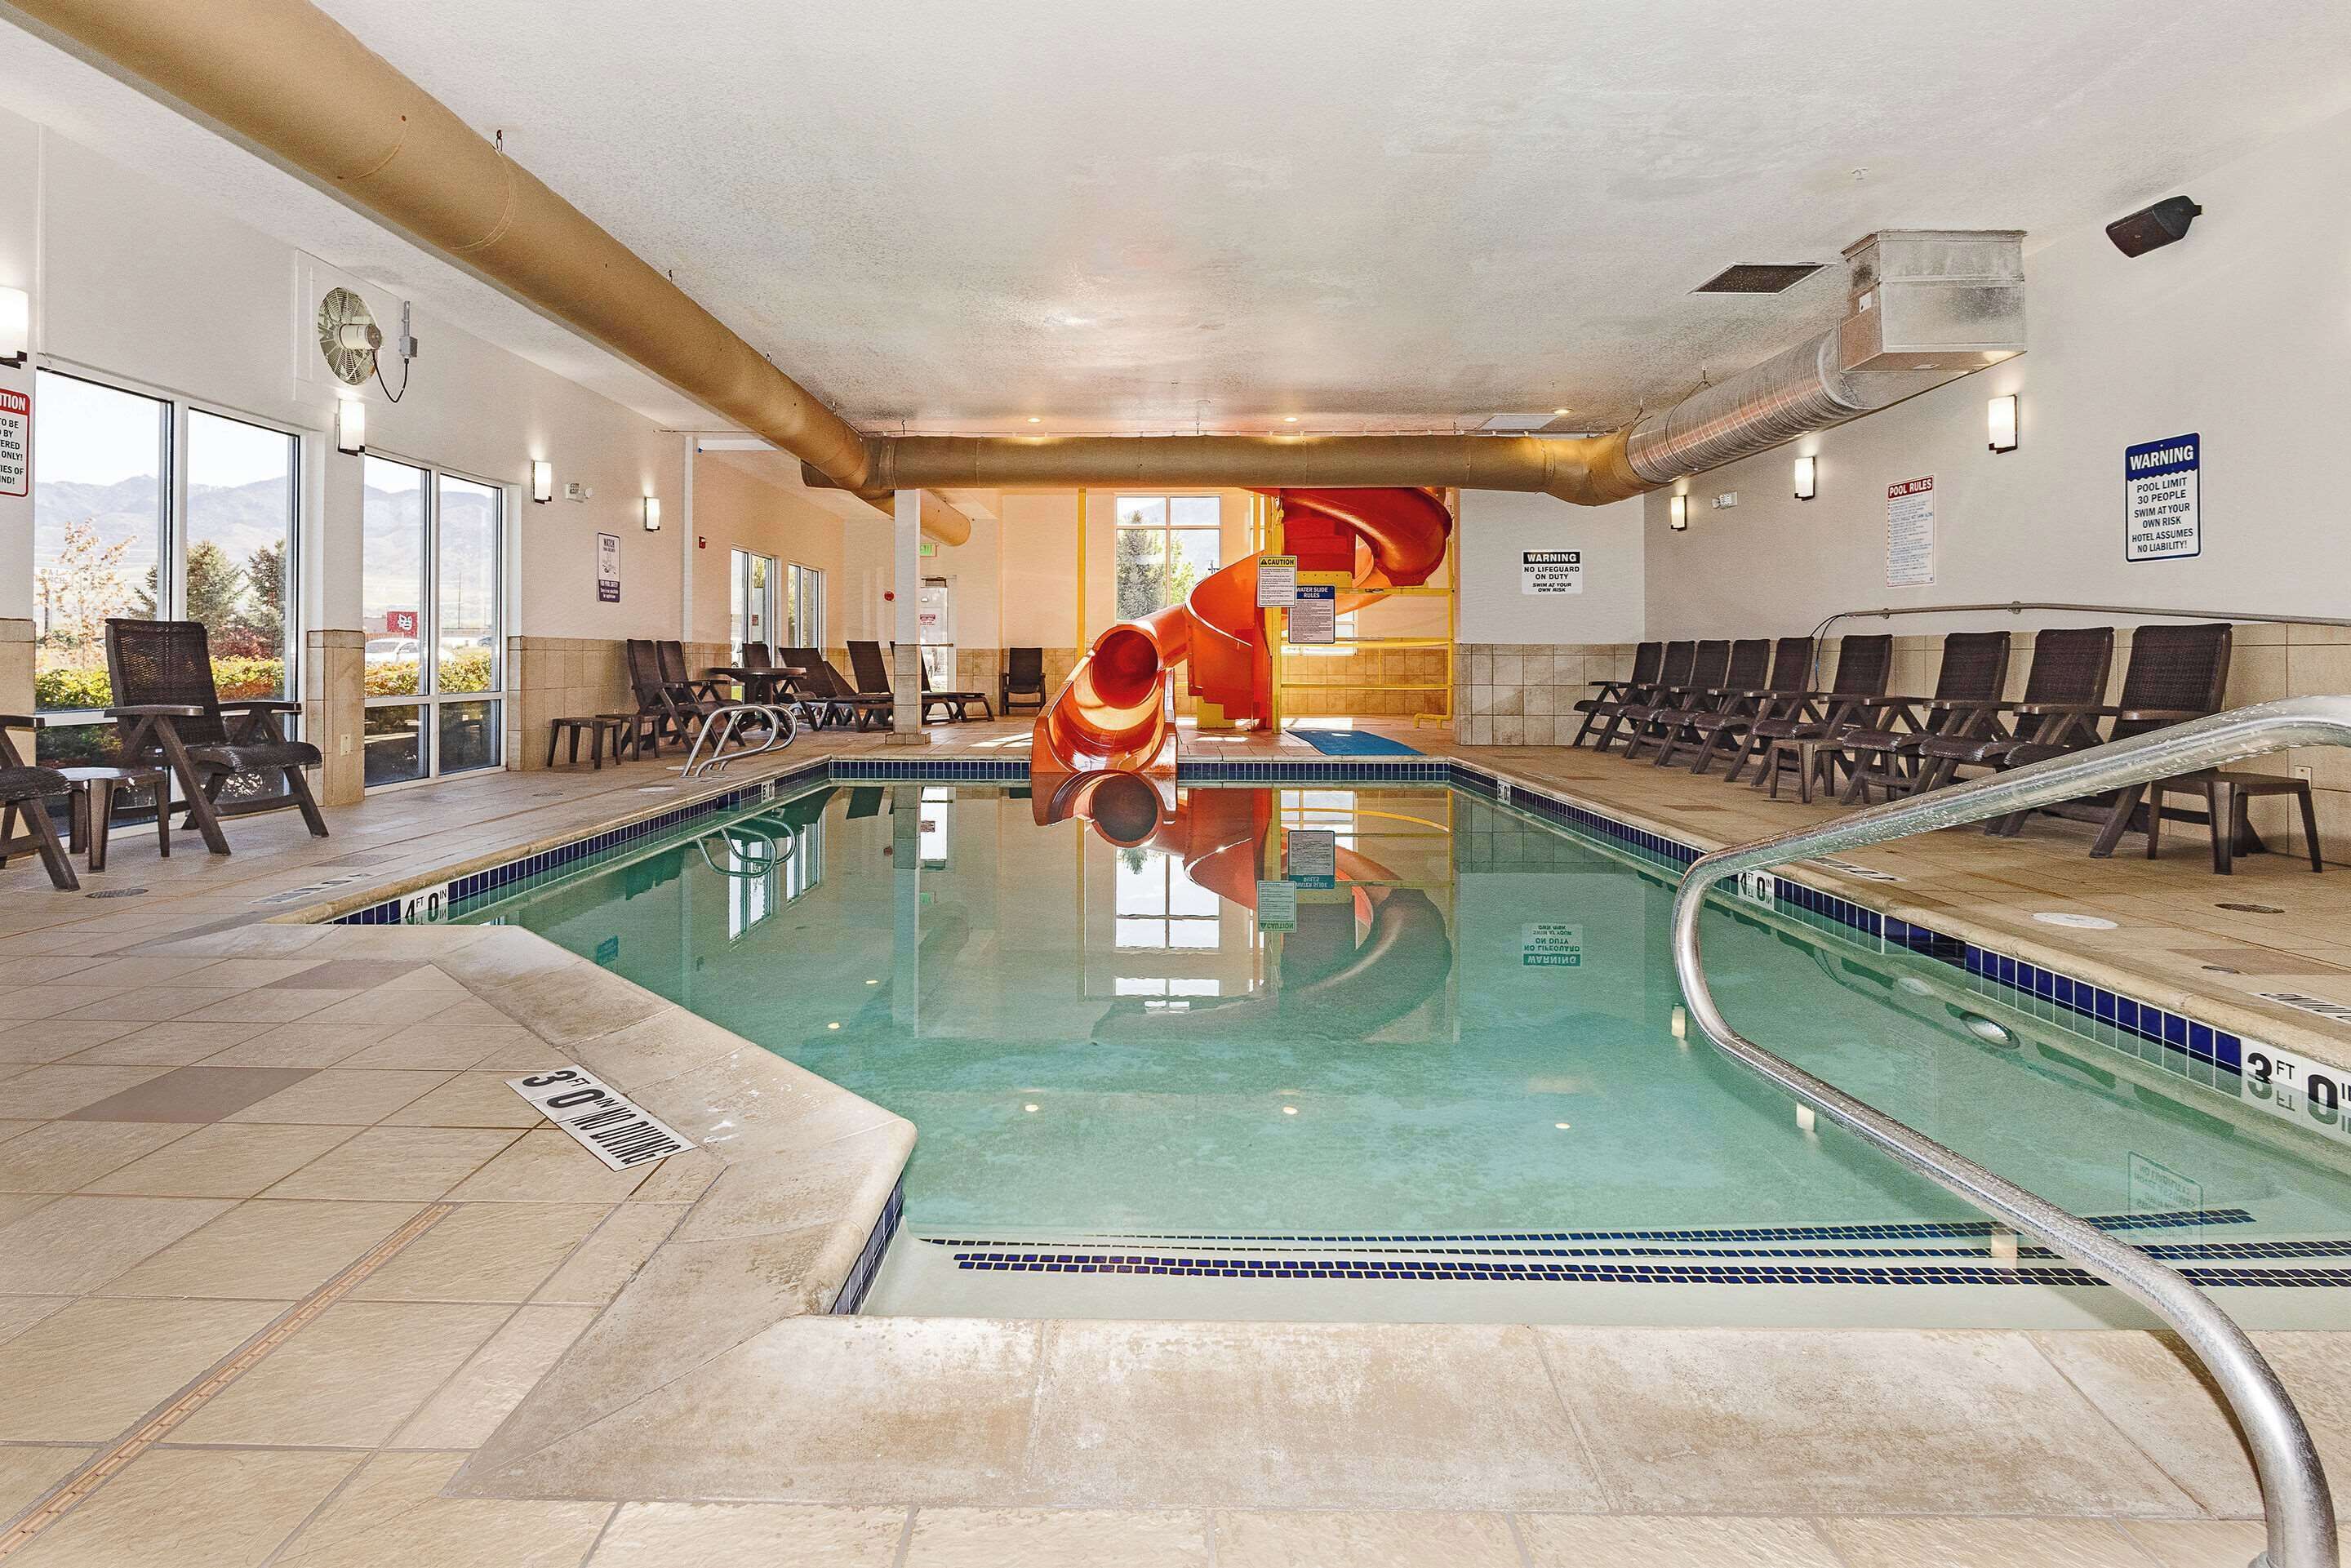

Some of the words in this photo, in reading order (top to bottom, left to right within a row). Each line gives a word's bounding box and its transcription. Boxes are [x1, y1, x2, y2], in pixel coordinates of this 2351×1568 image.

[9, 420, 19, 429] BE
[3, 429, 13, 438] BY
[3, 451, 23, 461] ONLY!
[2130, 445, 2194, 471] WARNING
[14, 467, 24, 475] OF
[1890, 485, 1908, 497] POOL
[1909, 479, 1932, 493] RULES
[2137, 482, 2160, 493] POOL
[2162, 478, 2187, 489] LIMIT
[2137, 495, 2149, 504] 30
[2151, 490, 2186, 503] PEOPLE
[2134, 508, 2156, 518] SWIM
[2158, 506, 2167, 515] AT
[2168, 502, 2190, 513] YOUR
[2142, 518, 2161, 529] OWN
[2162, 516, 2181, 526] RISK
[2131, 533, 2155, 543] HOTEL
[2156, 528, 2193, 540] ASSUMES
[2137, 544, 2148, 553] NO
[2149, 540, 2187, 552] LIABILITY!
[1527, 553, 1577, 562] WARNING
[405, 899, 415, 919] 4
[416, 896, 424, 908] FT
[428, 893, 439, 922] 0
[439, 889, 447, 899] IN
[522, 1070, 577, 1087] 3
[567, 1077, 591, 1087] FT
[2247, 1052, 2273, 1084] 3
[2276, 1060, 2295, 1080] FT
[2307, 1074, 2339, 1120] 0
[2341, 1082, 2351, 1102] I
[546, 1089, 606, 1108] 0
[594, 1097, 620, 1108] IN
[571, 1107, 637, 1130] NO
[589, 1121, 682, 1165] DIVING
